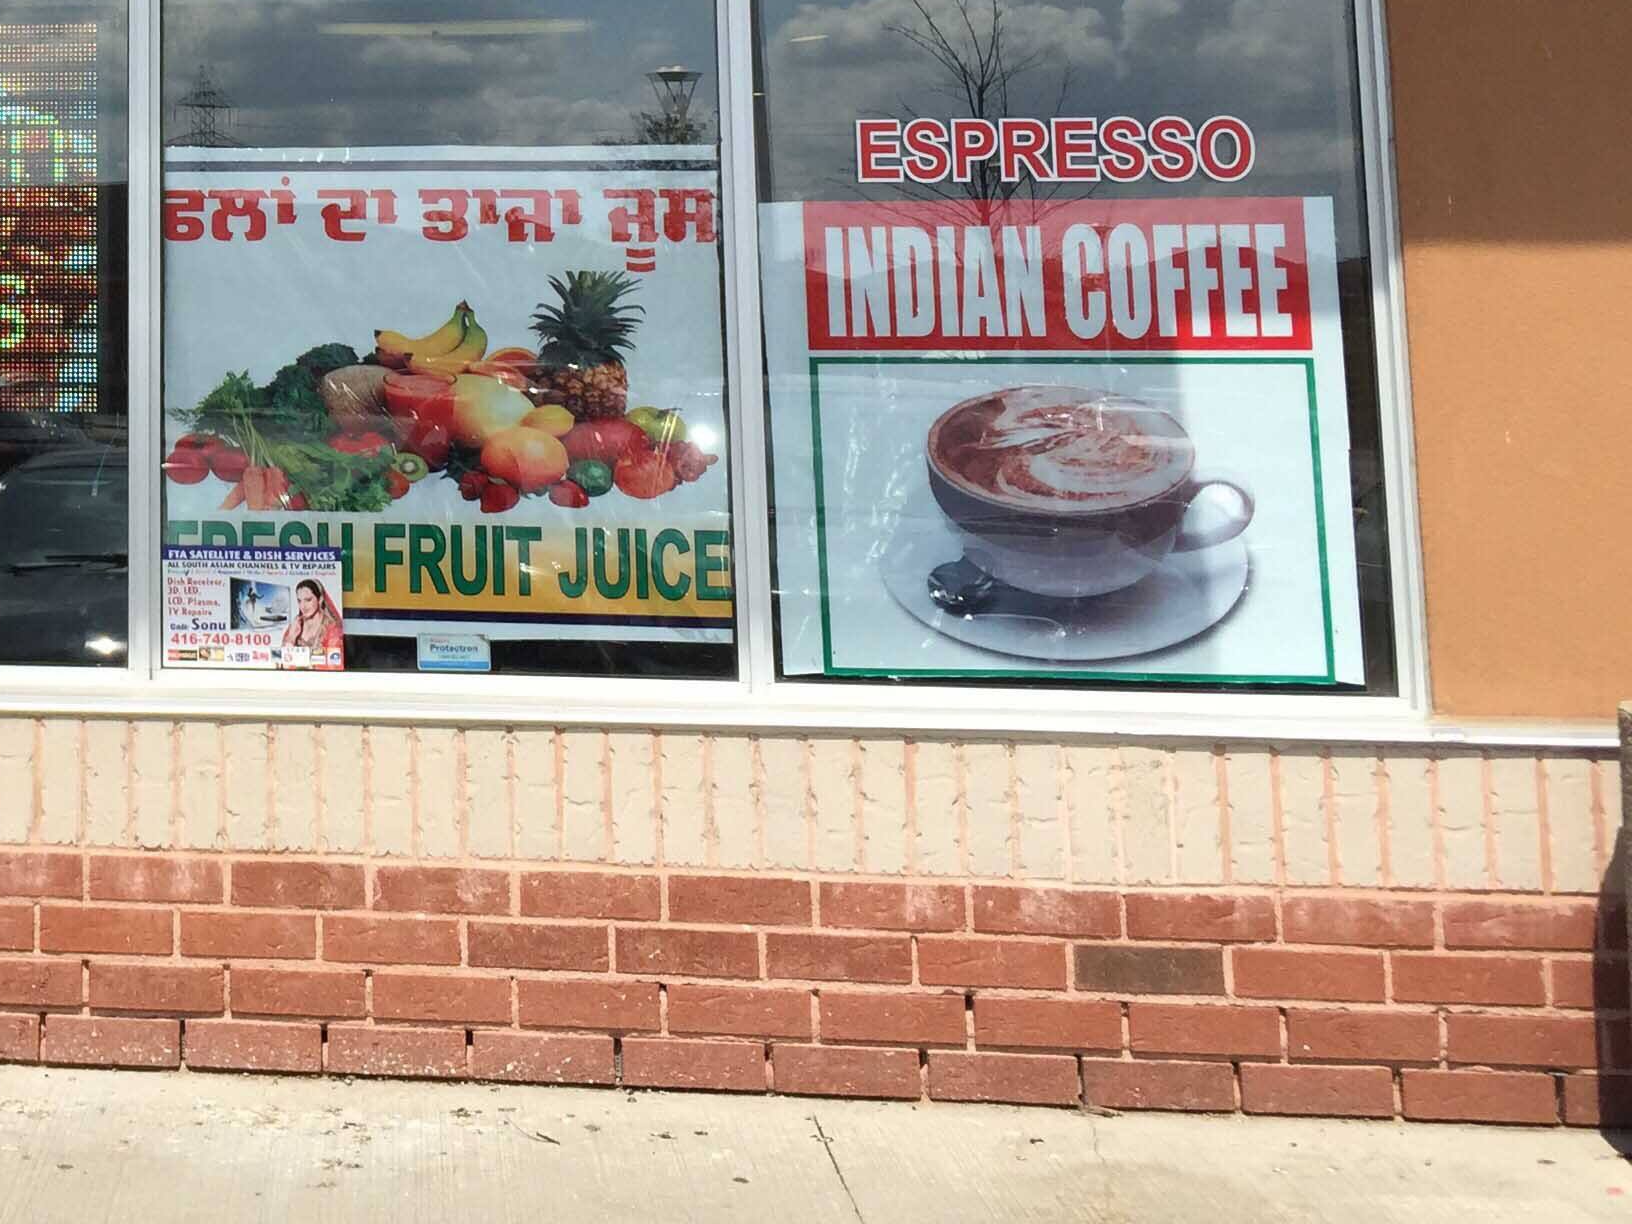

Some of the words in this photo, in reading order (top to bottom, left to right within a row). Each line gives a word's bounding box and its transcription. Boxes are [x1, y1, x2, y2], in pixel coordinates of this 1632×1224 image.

[856, 116, 1255, 182] ESPRESSO
[317, 189, 397, 242] ਦਾ
[824, 224, 1047, 337] INDIAN
[1062, 222, 1294, 340] COFFEE
[190, 550, 240, 561] SATELLITE
[243, 551, 250, 560] &
[255, 551, 282, 561] DISH
[285, 551, 336, 561] SERVICES
[235, 562, 279, 570] CHANNELS
[374, 522, 542, 597] FRUIT
[559, 525, 733, 602] JUICE
[192, 618, 226, 631] Sonu
